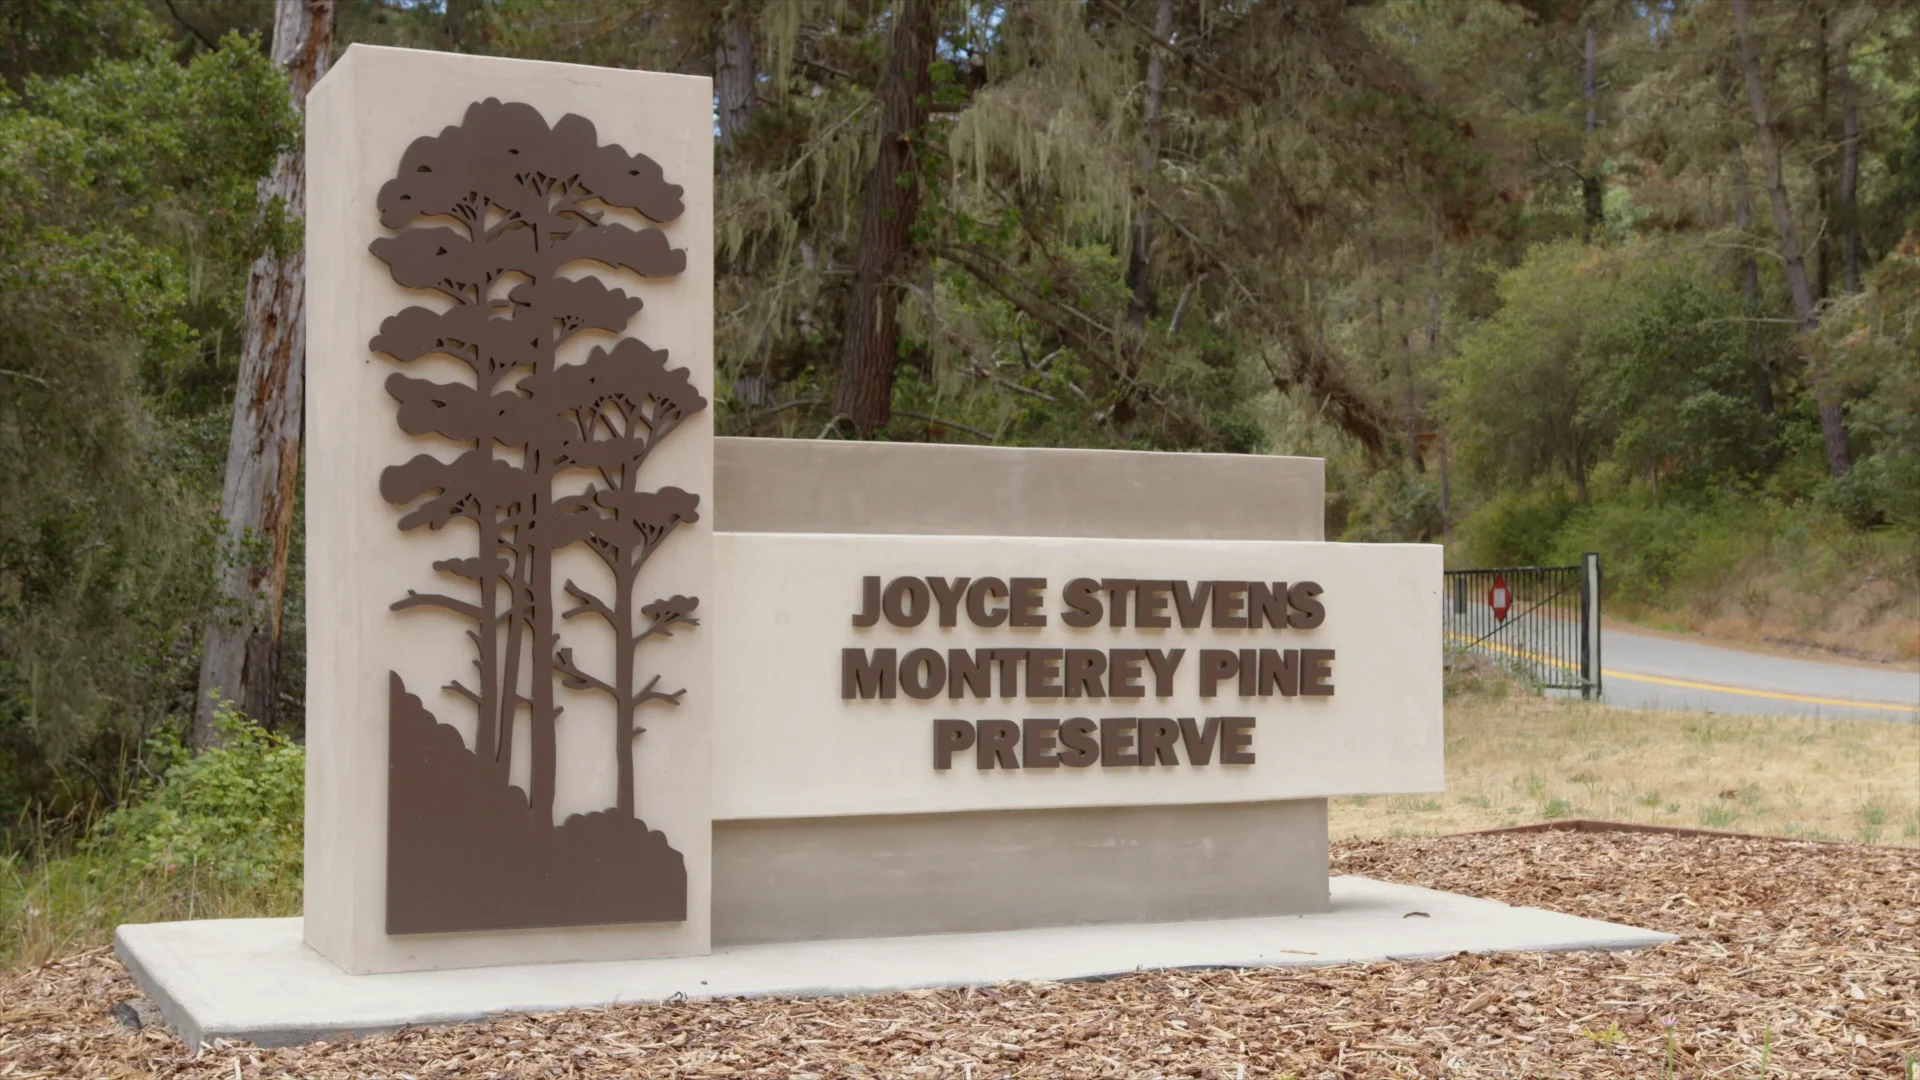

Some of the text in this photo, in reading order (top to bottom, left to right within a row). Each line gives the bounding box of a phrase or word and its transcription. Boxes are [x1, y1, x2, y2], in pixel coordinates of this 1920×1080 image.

[852, 575, 1326, 630] JOYCE STEVENS
[841, 647, 1336, 700] MONTEREY PINE
[933, 716, 1256, 771] PRESERVE
